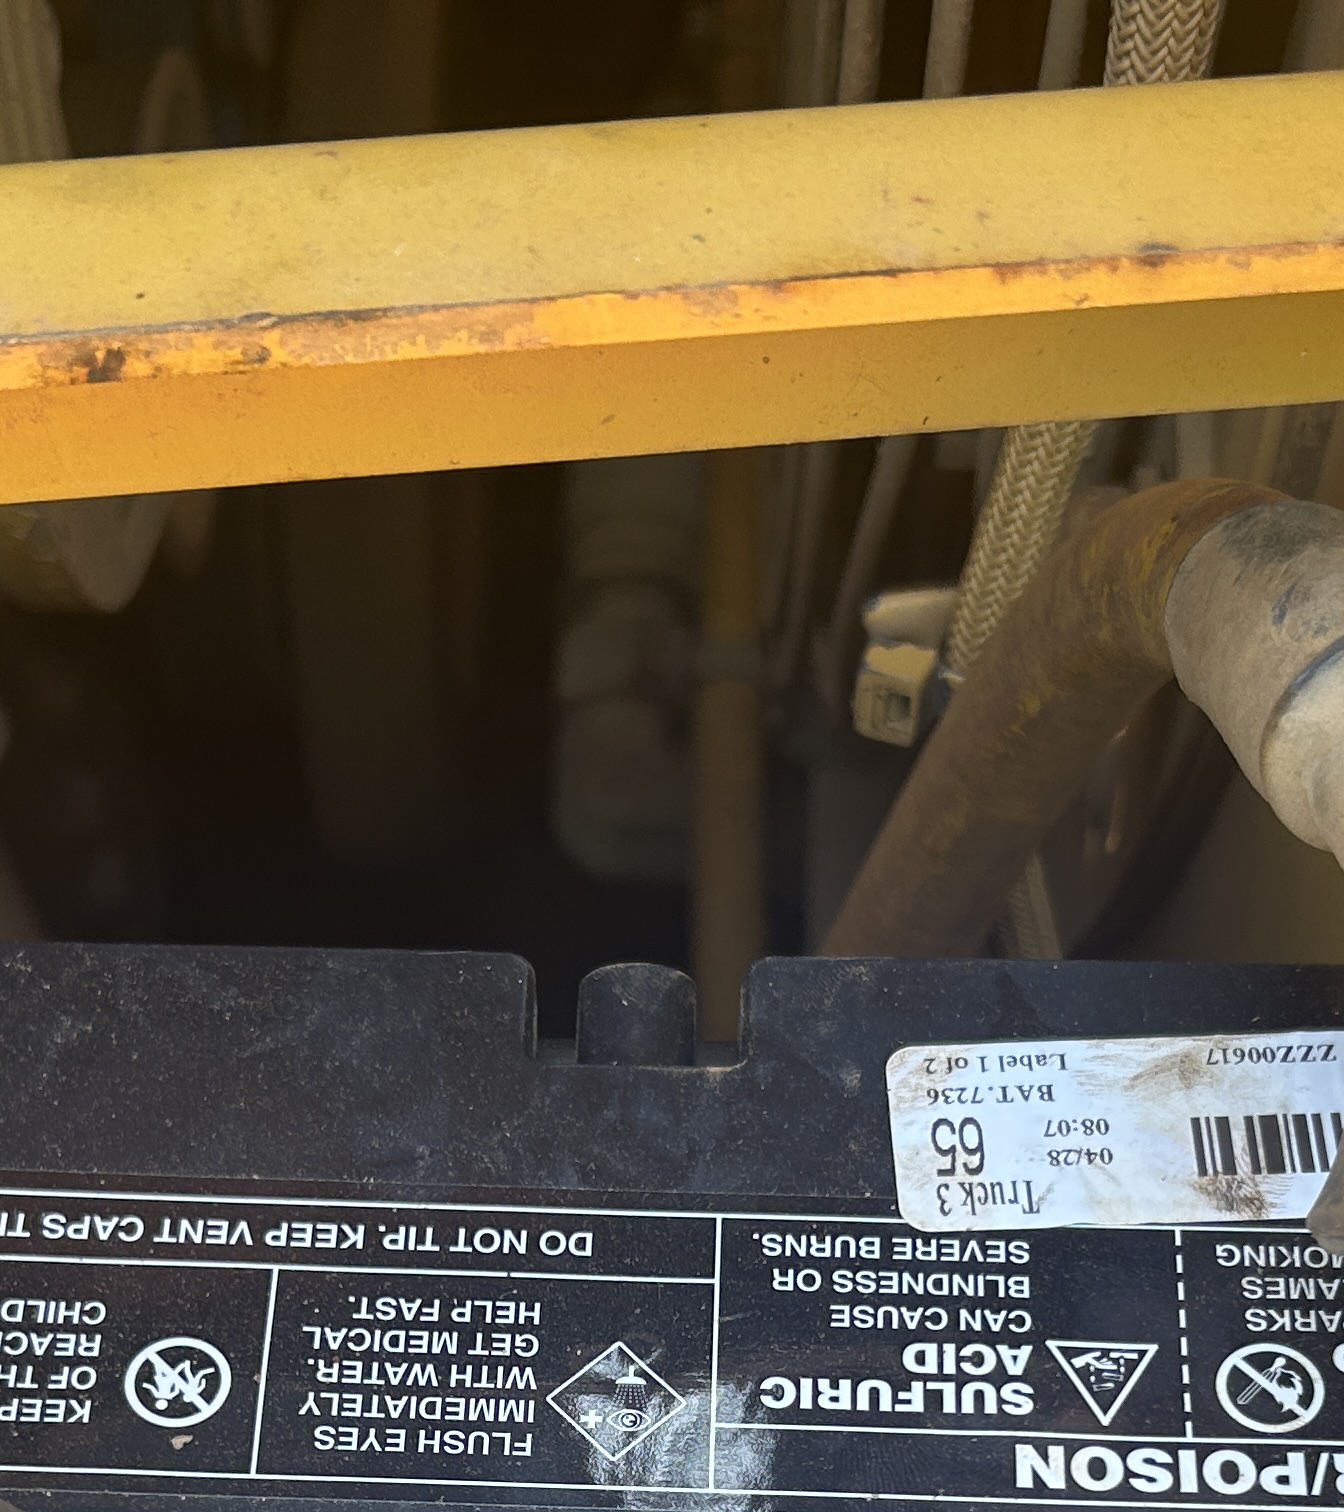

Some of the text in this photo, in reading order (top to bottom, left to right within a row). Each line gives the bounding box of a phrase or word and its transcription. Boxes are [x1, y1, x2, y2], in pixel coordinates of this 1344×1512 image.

[923, 1053, 1067, 1074] Label 1 of 2
[1206, 1044, 1336, 1066] ZZZ00617
[927, 1084, 1054, 1105] BAT.7236
[1043, 1118, 1109, 1137] 08:07
[930, 1117, 985, 1176] 65
[1046, 1147, 1113, 1166] 04/28
[936, 1180, 1040, 1216] Truck 3
[40, 1211, 144, 1242] CAPS
[151, 1215, 253, 1244] VENT
[266, 1221, 365, 1250] KEEP
[379, 1225, 440, 1251] TIP.
[450, 1227, 528, 1254] NOT
[539, 1230, 593, 1257] DO
[753, 1234, 1030, 1264] SEVERE BURNS.
[772, 1269, 1030, 1298] BLINDNESS OR
[348, 1296, 542, 1325] HELP FAST.
[830, 1305, 1032, 1332] CAN CAUSE
[302, 1326, 540, 1356] GET MEDICAL
[902, 1342, 1033, 1375] ACID
[48, 1363, 98, 1391] OF
[305, 1359, 536, 1390] WITH WATER.
[298, 1391, 535, 1422] IMMEDIATELY
[759, 1377, 1034, 1415] SULFURIC
[313, 1425, 533, 1456] FLUSH EYES
